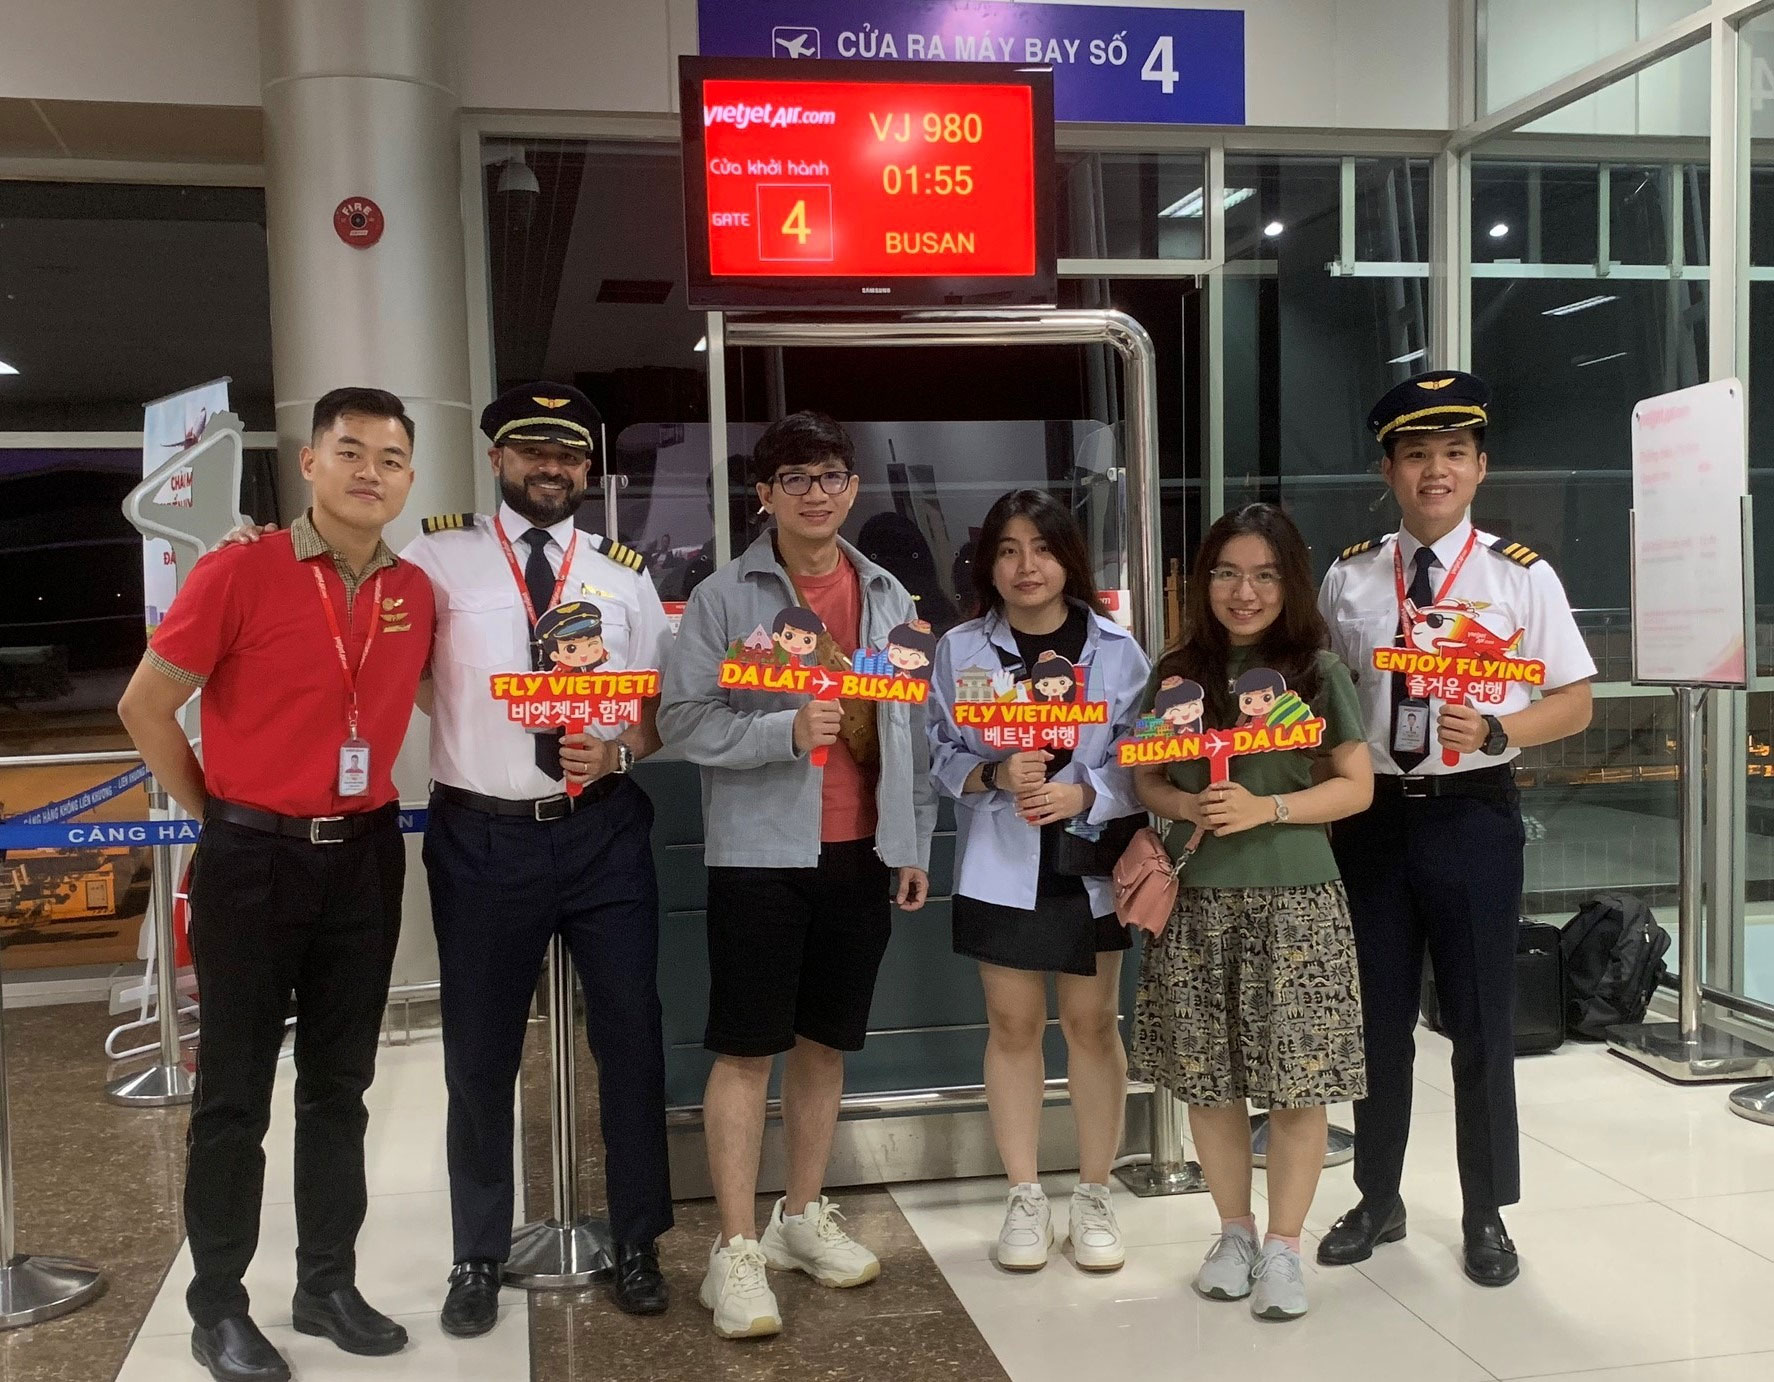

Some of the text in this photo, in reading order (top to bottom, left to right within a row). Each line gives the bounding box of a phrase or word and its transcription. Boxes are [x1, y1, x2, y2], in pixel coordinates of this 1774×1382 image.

[838, 23, 1179, 94] CỬA RA MÁY BAY SỐ 4
[869, 112, 983, 143] VJ 980
[710, 157, 829, 176] Cửa khởi hành
[882, 164, 974, 195] 01:55
[341, 202, 373, 216] FIRE
[712, 213, 750, 227] GATE
[781, 199, 812, 245] 4
[885, 231, 975, 254] BUSAN
[1375, 651, 1545, 684] ENJOY FLYING
[493, 674, 656, 698] FLY VIETJET!
[722, 663, 926, 702] DA LAT BUSAN
[1409, 674, 1504, 704] 즐거운 여행
[511, 698, 638, 725] 비엣젯과 함께
[955, 704, 1104, 723] FLY VIETNAM
[984, 725, 1076, 748] 베트남 여행
[1120, 721, 1321, 765] BUSAN DA LAT
[158, 821, 202, 840] HÀ
